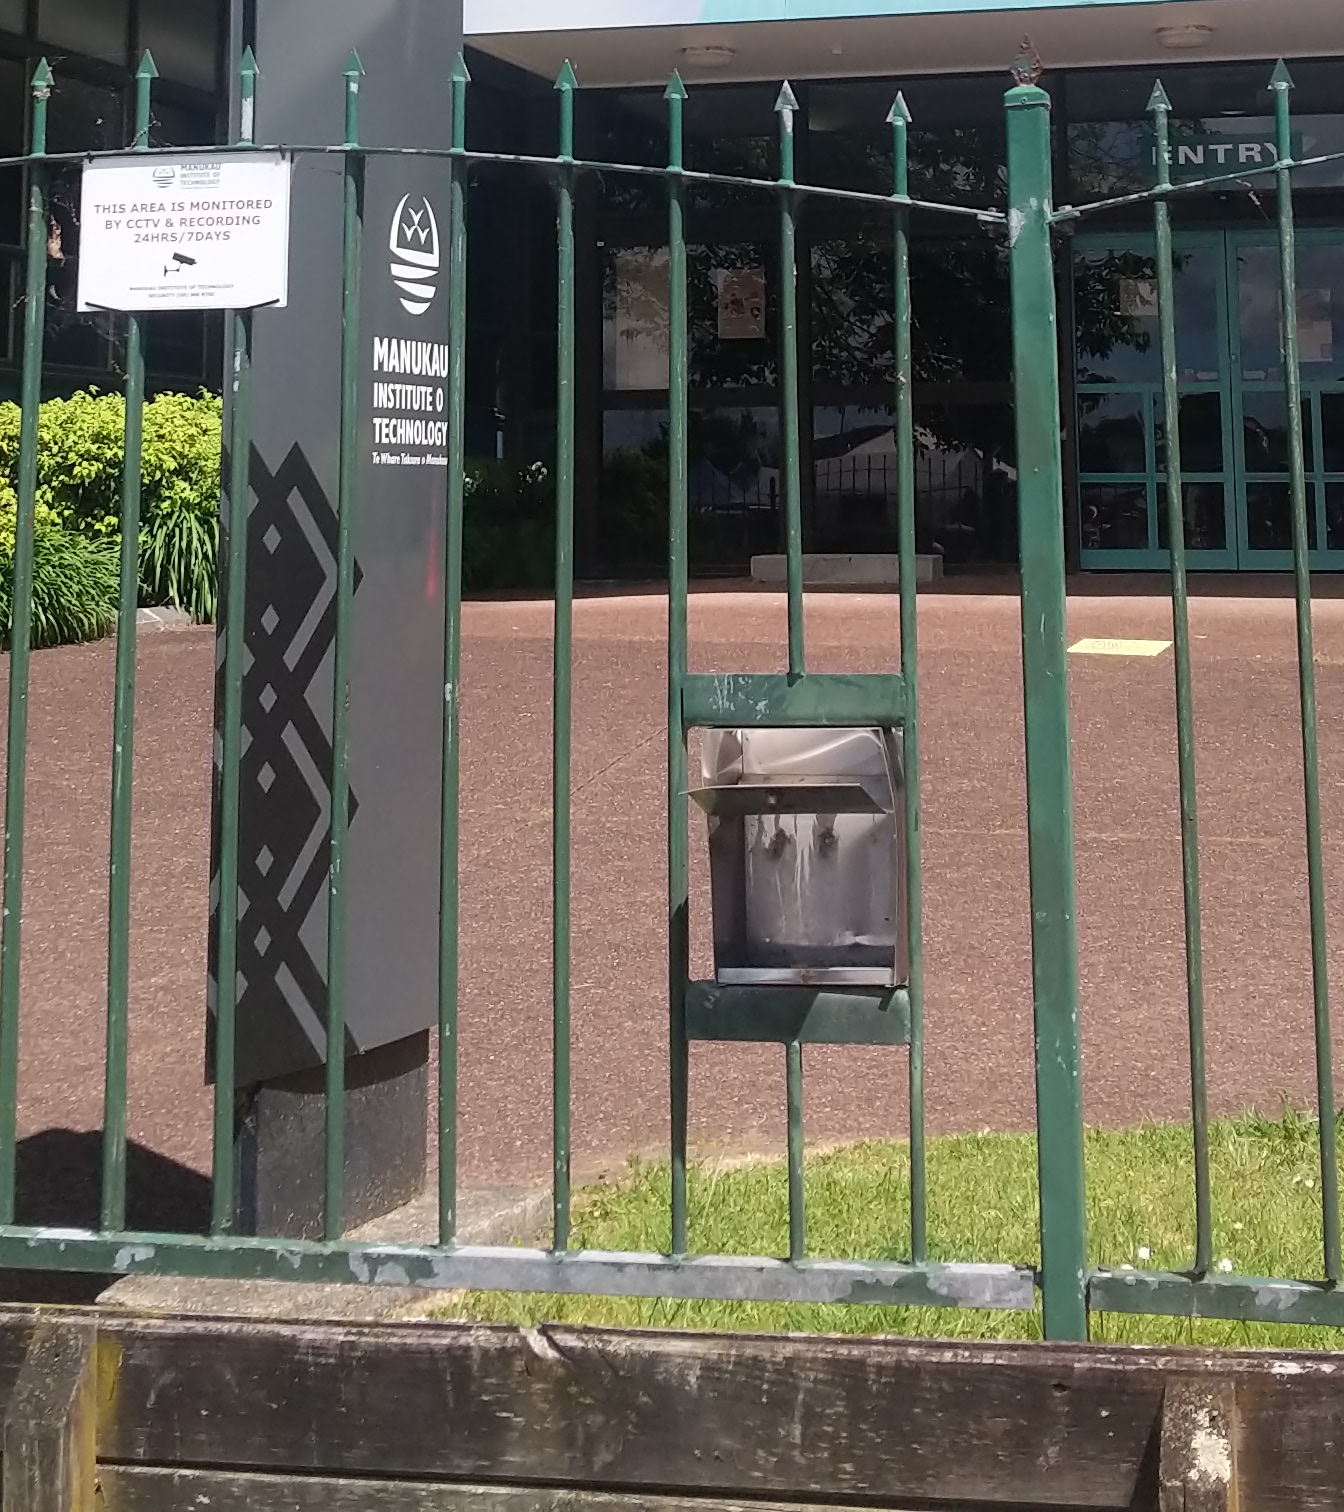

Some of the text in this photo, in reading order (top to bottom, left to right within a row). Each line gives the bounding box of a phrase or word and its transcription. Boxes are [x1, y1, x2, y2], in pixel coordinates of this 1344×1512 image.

[94, 199, 273, 214] THIS AREA IS MONITORED
[105, 215, 261, 230] BY CCTV & RECORDING
[134, 230, 231, 244] 24HRS/7DAYS
[373, 336, 449, 378] MANUKAU
[373, 382, 433, 411] INSTITUTE
[372, 417, 449, 446] TECHNOLOGY
